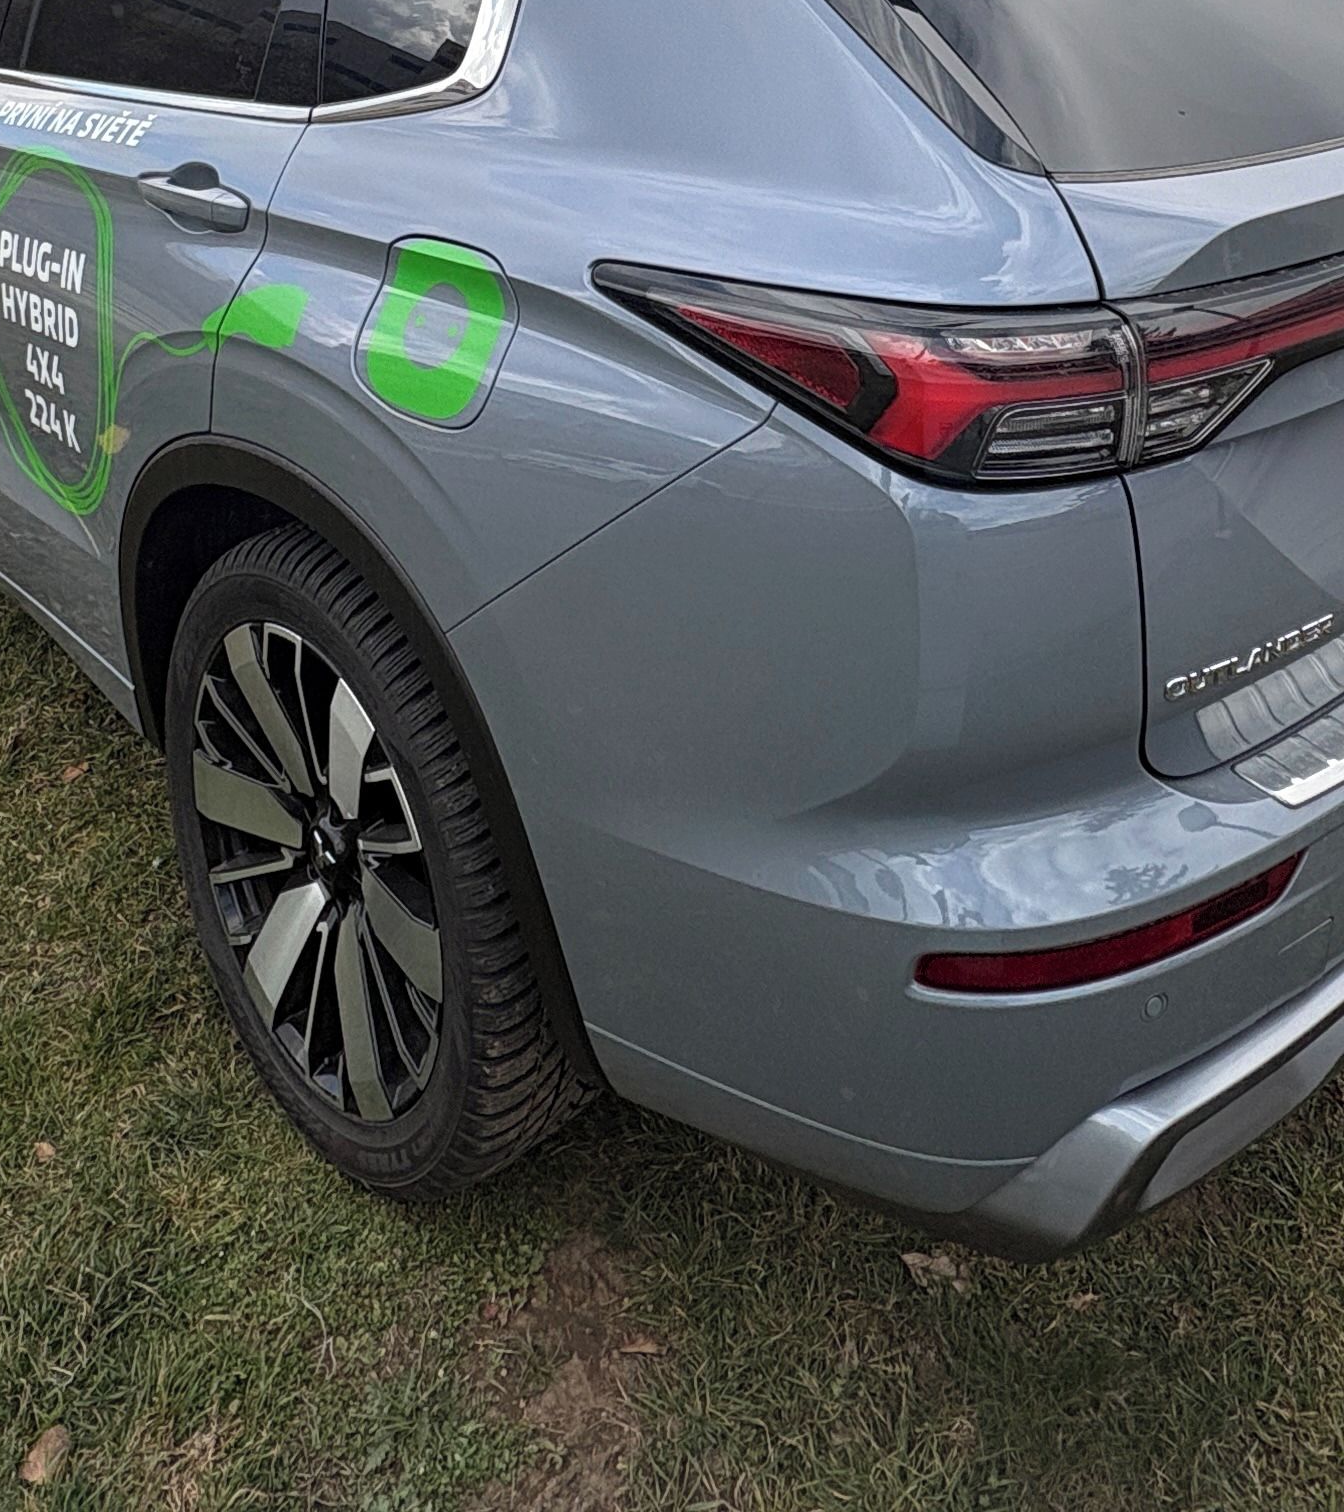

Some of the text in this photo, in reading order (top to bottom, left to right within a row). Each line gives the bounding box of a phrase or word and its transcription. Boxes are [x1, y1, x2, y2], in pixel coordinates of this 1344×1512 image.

[46, 107, 84, 136] NA
[76, 109, 158, 147] SVĚTĚ
[0, 282, 79, 348] HYBRID
[25, 343, 65, 395] 4X4
[24, 388, 82, 454] 224 K
[1164, 613, 1335, 701] OUTLANDER
